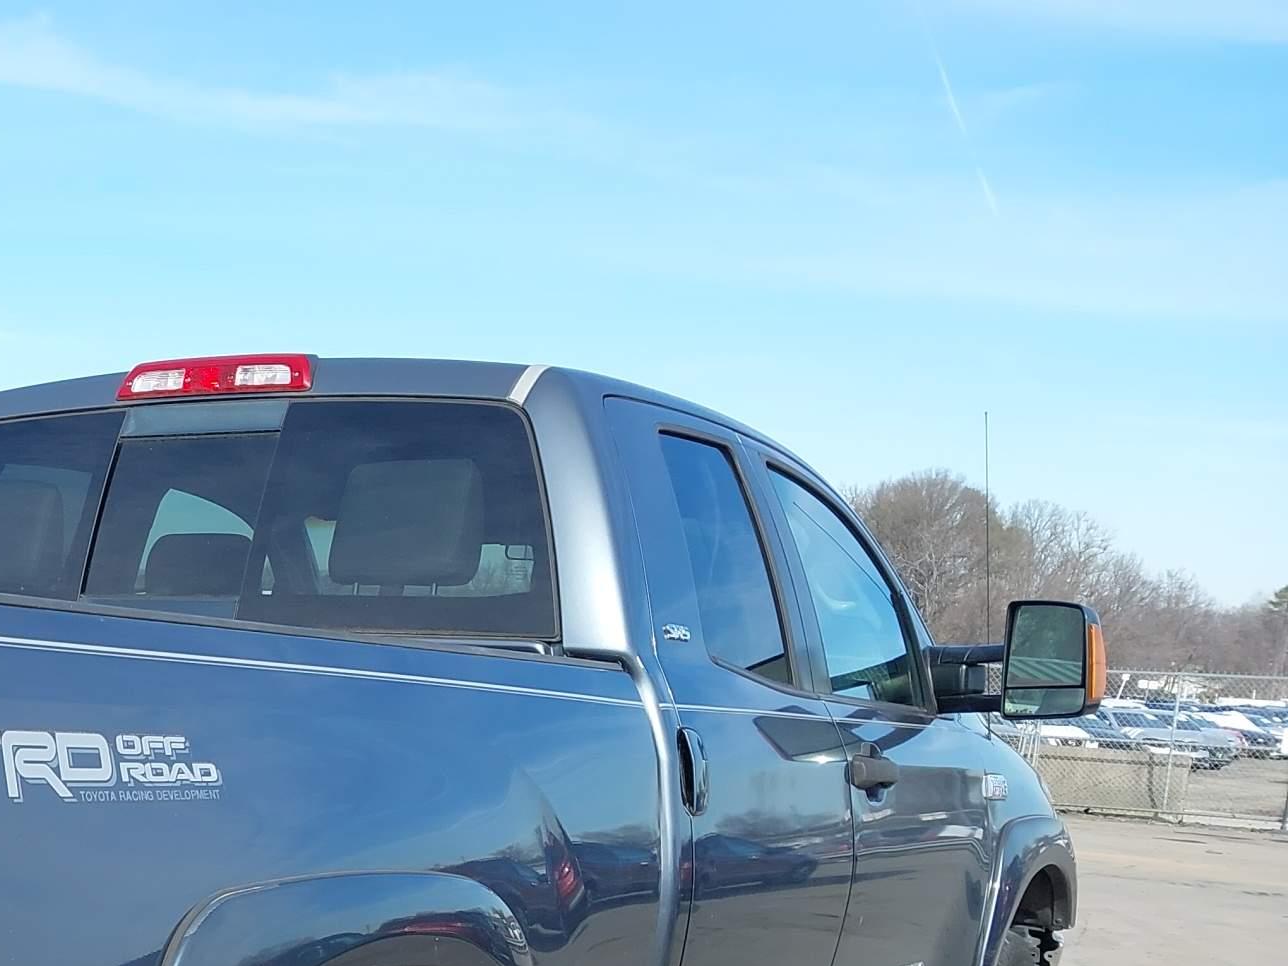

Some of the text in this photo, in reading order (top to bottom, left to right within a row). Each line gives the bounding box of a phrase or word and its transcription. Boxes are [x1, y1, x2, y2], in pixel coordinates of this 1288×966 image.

[115, 734, 189, 759] OFF
[119, 762, 222, 786] ROAD
[79, 789, 220, 801] TOYOTA RACING DEVELOPMENT
